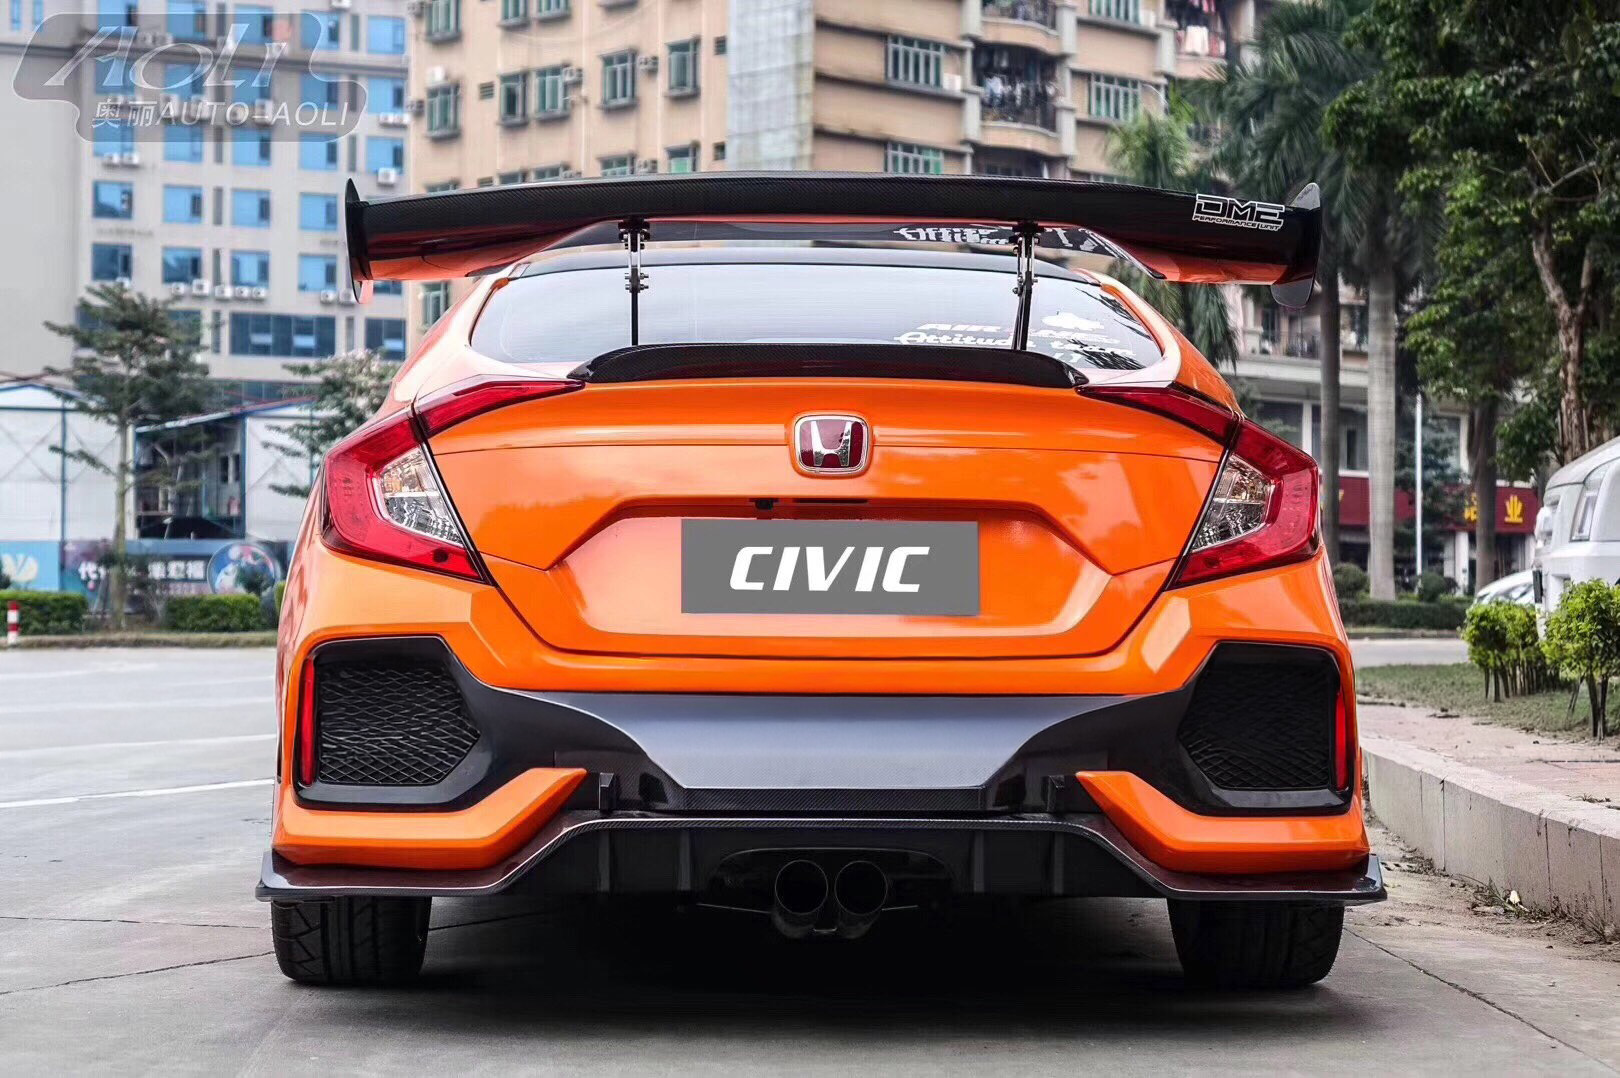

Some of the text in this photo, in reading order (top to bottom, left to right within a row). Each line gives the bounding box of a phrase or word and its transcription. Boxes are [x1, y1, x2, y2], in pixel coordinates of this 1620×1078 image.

[1192, 213, 1281, 232] PERFORMANCE UNIT
[729, 546, 930, 592] CIVIC
